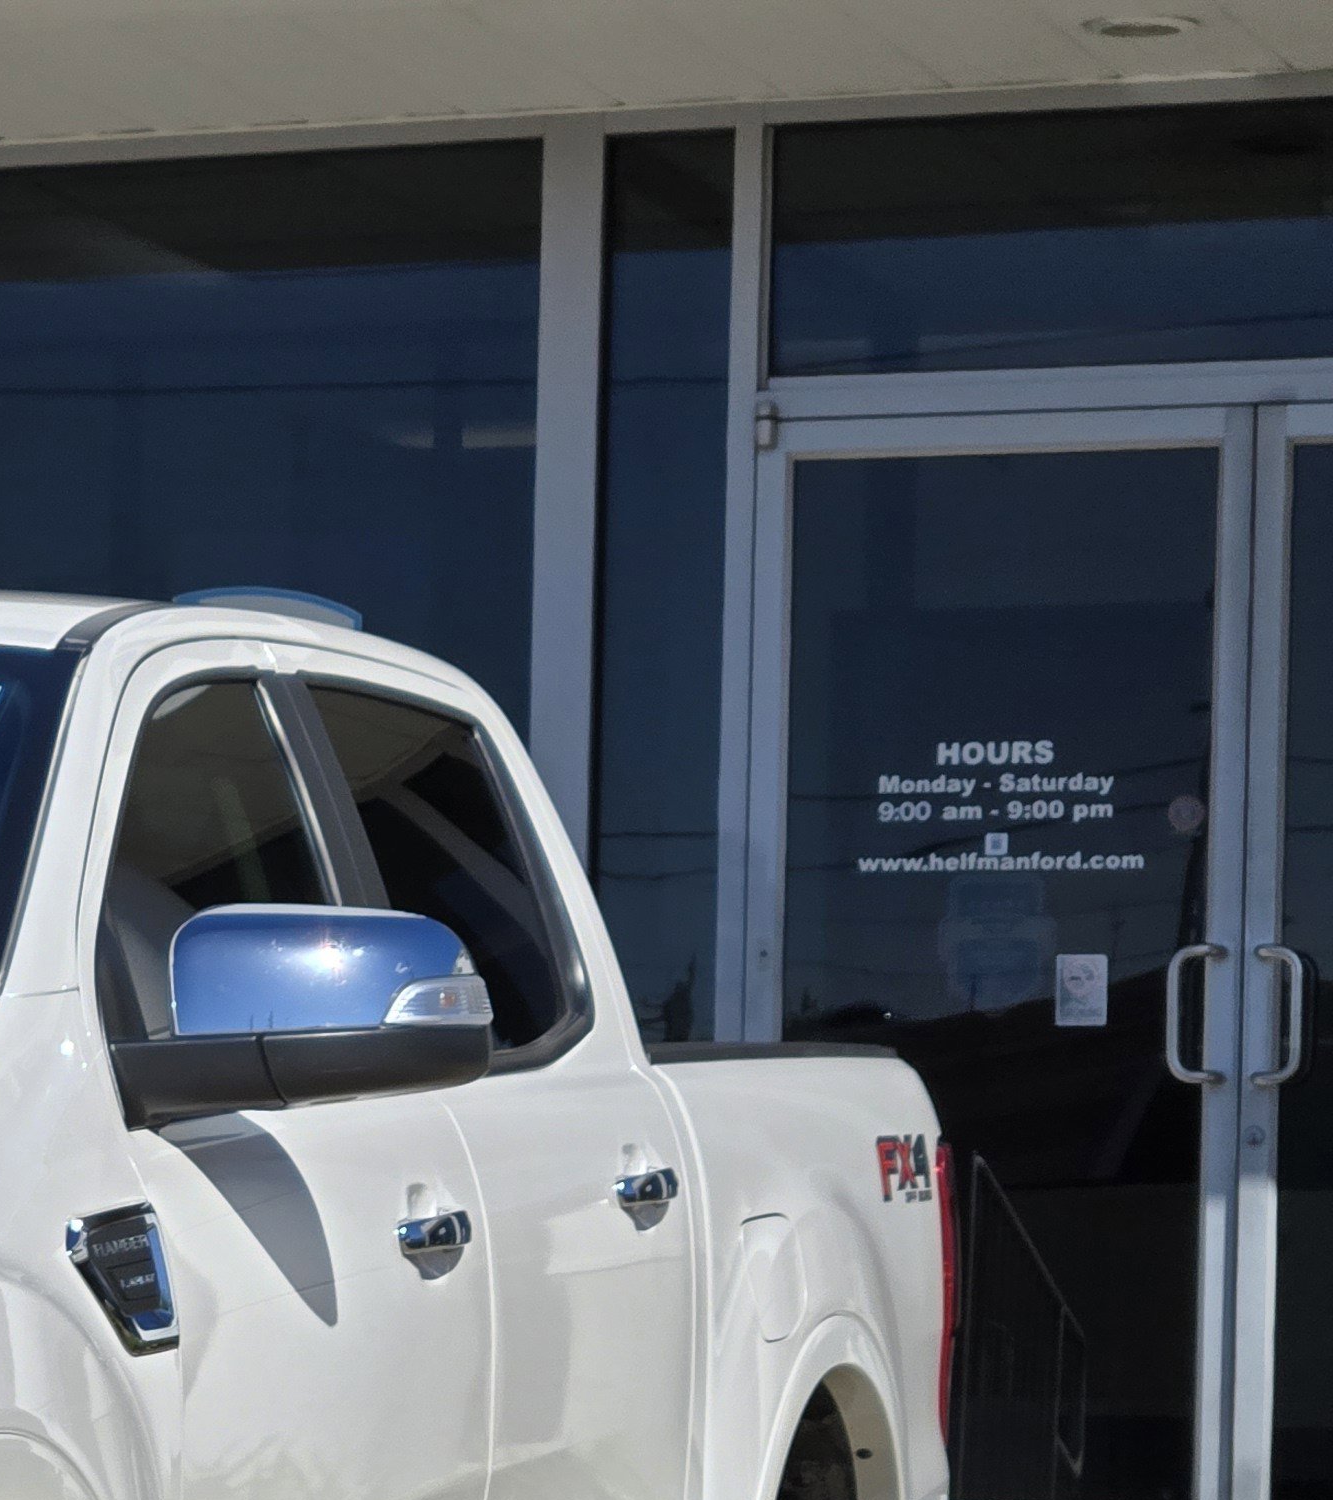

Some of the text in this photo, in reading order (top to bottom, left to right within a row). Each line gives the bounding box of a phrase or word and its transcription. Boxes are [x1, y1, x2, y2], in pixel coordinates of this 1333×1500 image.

[936, 740, 1054, 766] HOURS
[878, 774, 976, 797] Monday
[999, 772, 1115, 795] Saturday
[878, 801, 932, 822] 9:00
[942, 803, 983, 820] am
[1007, 799, 1065, 820] 9:00
[1073, 801, 1114, 823] pm
[857, 851, 1145, 872] www.helfmanford.com
[876, 1133, 931, 1202] FX4
